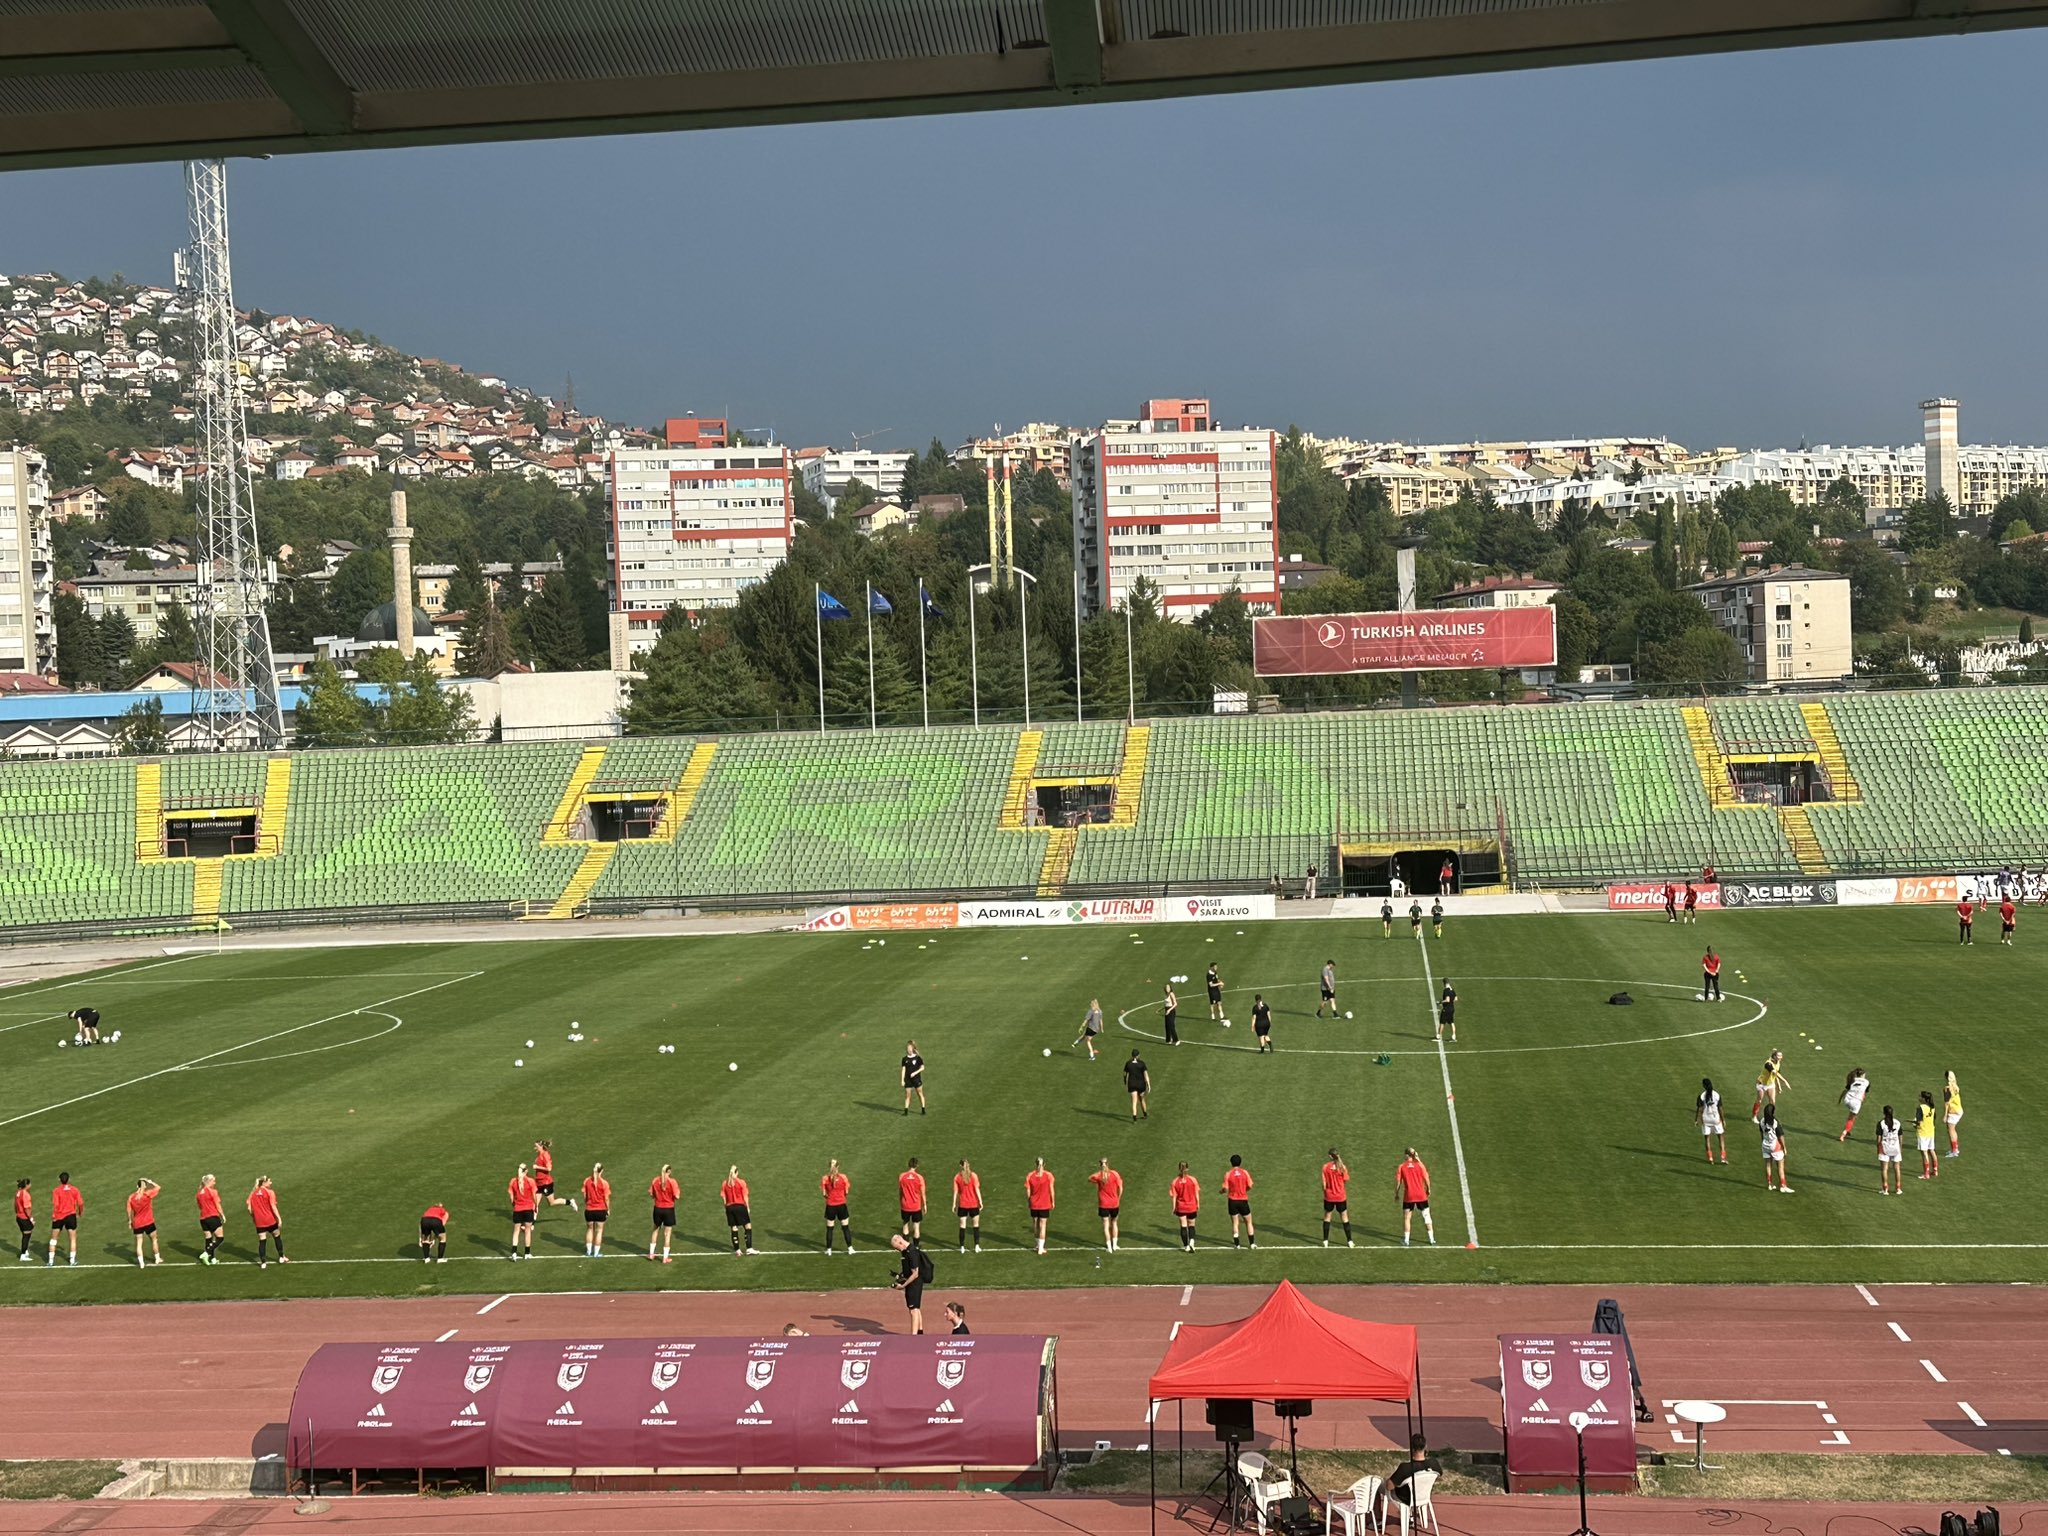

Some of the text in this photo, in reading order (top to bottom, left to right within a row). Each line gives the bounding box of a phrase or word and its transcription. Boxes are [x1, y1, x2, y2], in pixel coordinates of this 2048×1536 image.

[1351, 623, 1485, 639] TURKISH AIRLINES
[1748, 885, 1814, 898] AC BLOK
[1902, 882, 1928, 898] bh
[1091, 900, 1154, 915] LUTRIJA
[1199, 899, 1222, 907] VISIT
[977, 908, 1045, 919] ADMIRAL
[1200, 908, 1249, 916] SARAJEVO
